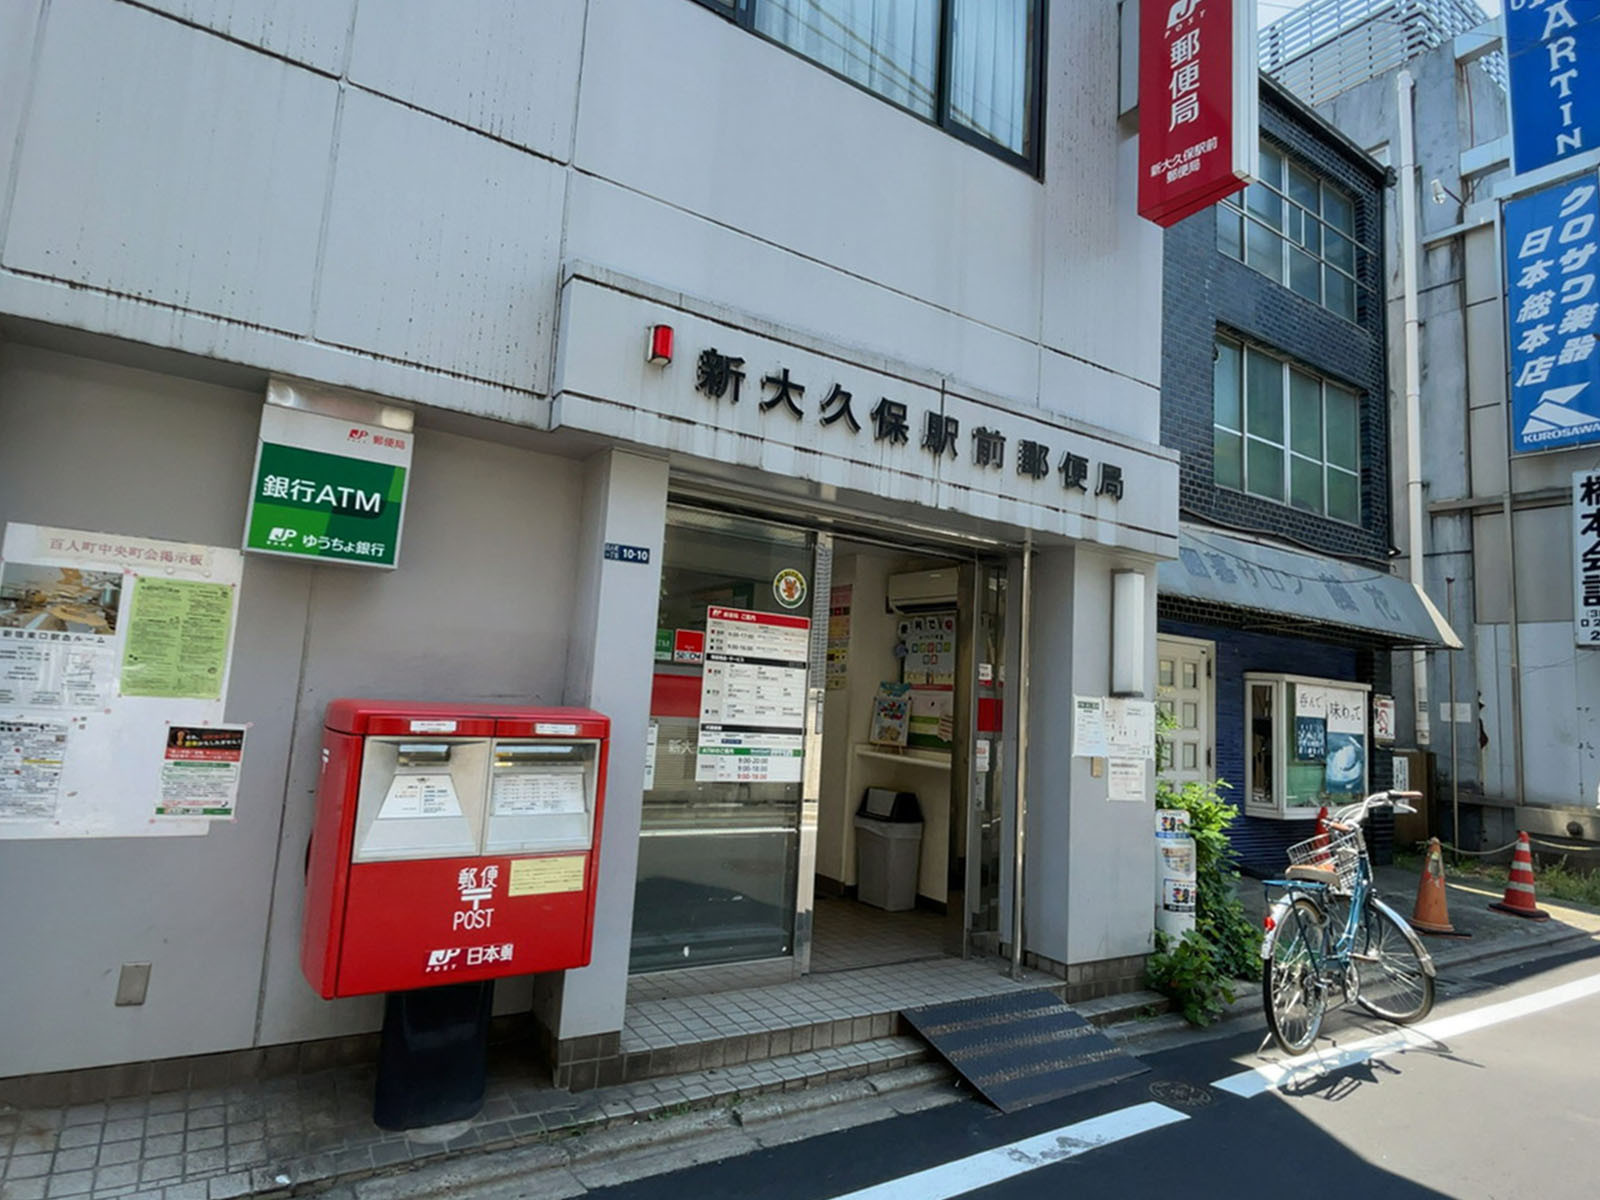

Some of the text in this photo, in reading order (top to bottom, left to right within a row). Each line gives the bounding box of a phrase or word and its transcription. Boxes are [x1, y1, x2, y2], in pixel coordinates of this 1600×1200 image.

[1169, 28, 1200, 132] 郵便局
[1528, 0, 1582, 155] ARTIN
[1150, 136, 1218, 178] 新大久保駅前
[1167, 158, 1201, 184] 郵便局
[1557, 185, 1599, 366] クロサワ楽器
[1515, 225, 1556, 388] 日本総本店
[695, 347, 1124, 502] 新大久保駅前郵便局
[1523, 422, 1600, 444] KUROSAWA
[373, 434, 405, 450] 郵便局
[262, 475, 381, 513] 銀行ATM
[302, 534, 385, 557] ゆうちょ銀行
[623, 548, 648, 561] 10-10
[457, 865, 498, 890] 郵便
[453, 908, 494, 931] POST
